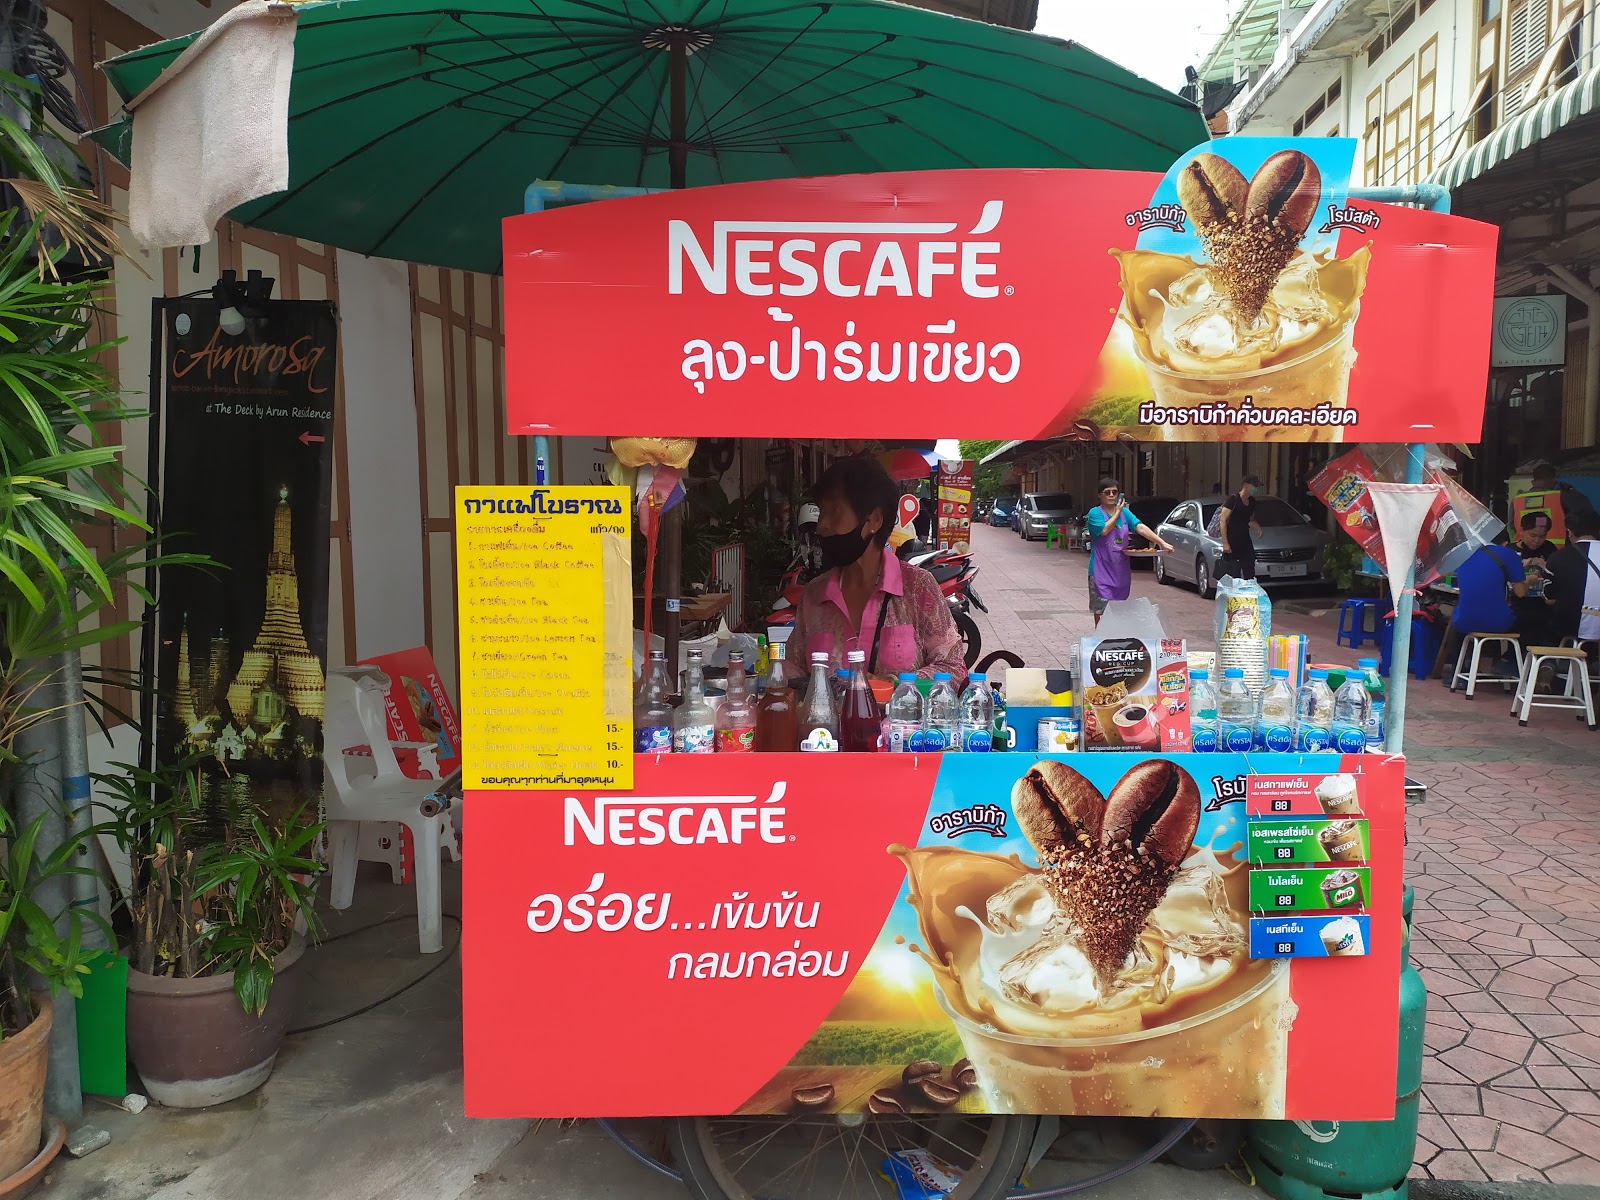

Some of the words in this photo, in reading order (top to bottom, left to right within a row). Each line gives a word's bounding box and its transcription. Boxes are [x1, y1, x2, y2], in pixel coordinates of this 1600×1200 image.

[1125, 202, 1187, 227] อาราบิก้า
[1328, 205, 1381, 230] โรบัสต้า
[668, 200, 1004, 298] NESCAFÉ
[681, 306, 1021, 395] ลุง-ป้าร่มเขียว
[172, 325, 328, 394] Amorosa
[205, 404, 213, 413] at
[214, 402, 232, 414] The
[236, 403, 254, 416] Deck
[255, 403, 264, 419] by
[265, 405, 288, 417] Arun
[291, 406, 332, 420] Residence
[1138, 396, 1359, 426] มีอาราบิก้าคั่วบดละเอียด
[464, 489, 622, 515] กาแฟโบราณ
[543, 541, 574, 551] Coffee
[533, 560, 560, 569] Black
[563, 560, 595, 569] Coffee
[531, 597, 548, 606] Tea
[542, 615, 569, 624] Black
[573, 615, 589, 625] Tea
[544, 634, 576, 643] Lemon
[580, 633, 597, 643] Tea
[552, 652, 568, 661] Tea
[1095, 645, 1144, 662] NESCAFÉ
[539, 670, 570, 679] Cocoa
[606, 723, 624, 733] 15.-
[606, 741, 624, 751] 15.-
[606, 760, 624, 769] 10.-
[1254, 777, 1309, 789] เนสกาแฟเย็น
[1274, 801, 1288, 811] 88
[565, 781, 787, 846] NESCAFÉ
[931, 803, 1006, 835] อาราบิก้า
[1252, 825, 1314, 838] เอสเพรสโซ่เย็น
[1277, 848, 1291, 858] 88
[1268, 875, 1304, 887] ไมโลเย็น
[1278, 895, 1292, 905] 88
[1336, 889, 1353, 902] MILO
[1266, 923, 1304, 934] เนสทีเย็น
[1278, 943, 1291, 953] 88
[667, 940, 850, 980] กลมกล่อม
